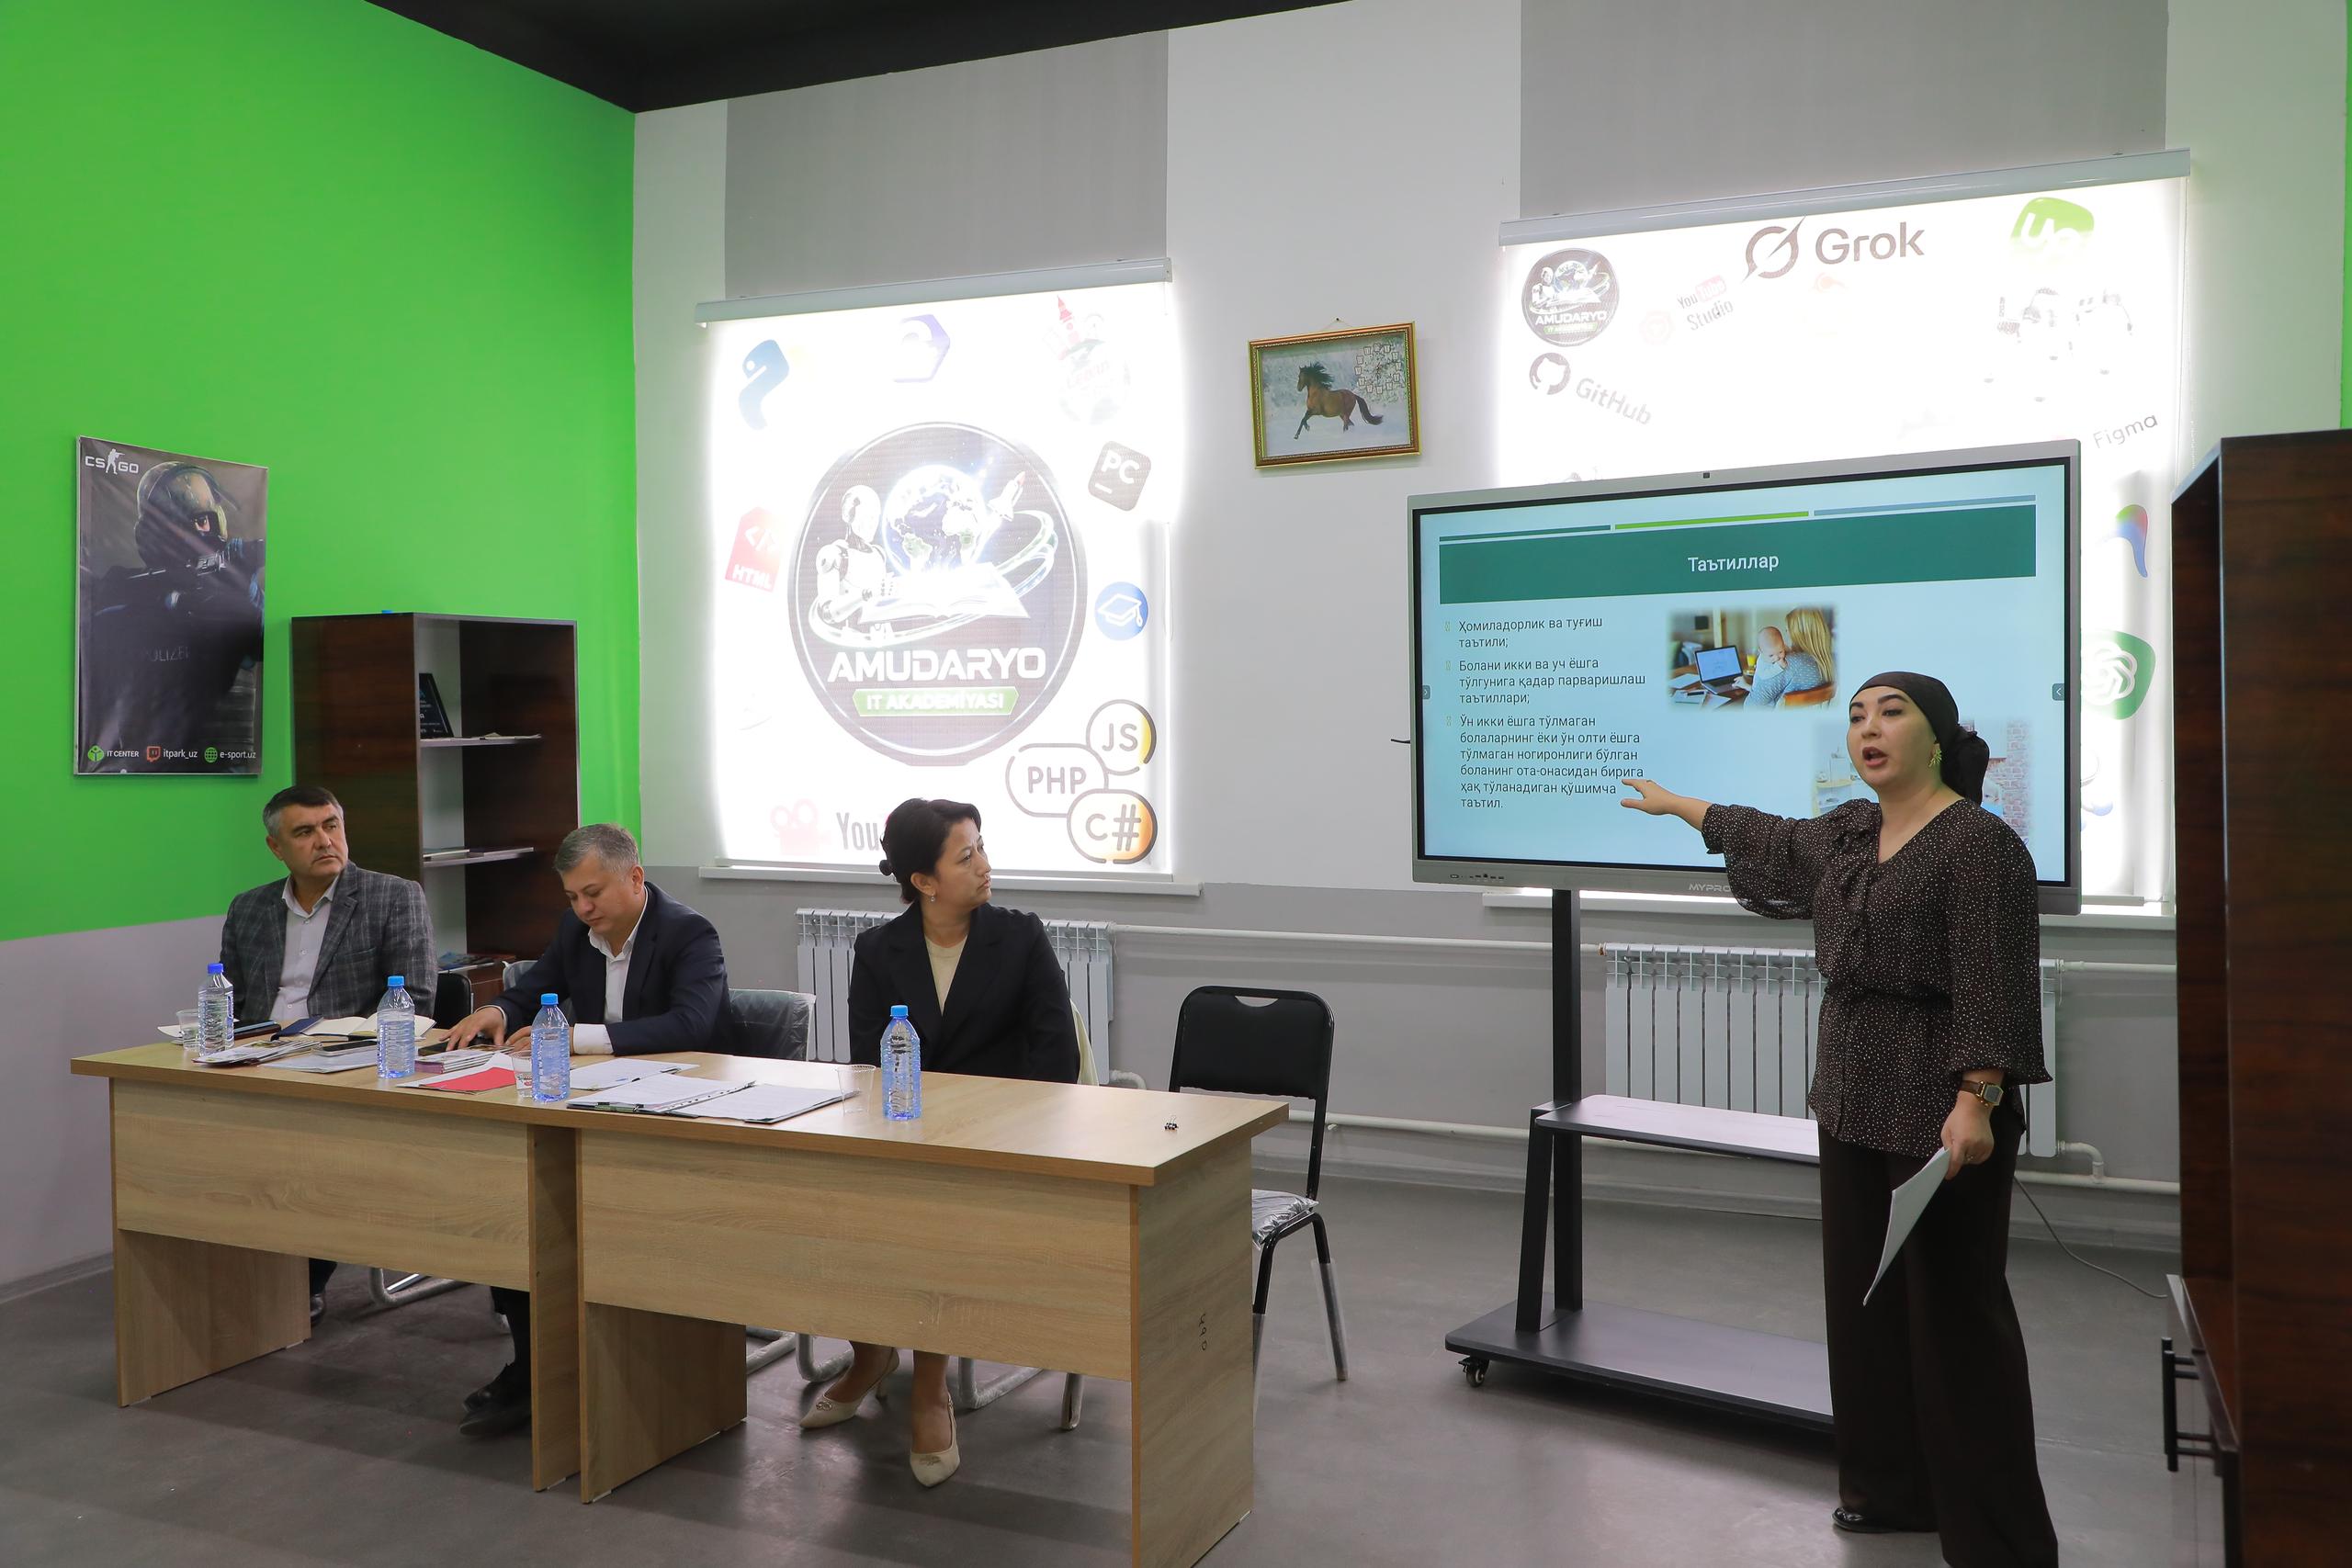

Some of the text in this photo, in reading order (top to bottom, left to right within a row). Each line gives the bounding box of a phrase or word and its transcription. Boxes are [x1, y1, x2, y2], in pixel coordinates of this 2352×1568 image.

[1815, 221, 1926, 265] Grok
[1534, 310, 1607, 325] AMUDARYO
[1686, 299, 1734, 331] Studio
[1575, 377, 1654, 425] GitHub
[2092, 414, 2159, 449] Figma
[1101, 449, 1140, 485] PC
[1688, 555, 1780, 572] Таътиллар
[732, 564, 771, 589] HTML
[1459, 616, 1603, 634] Ҳомиладорлик ва туғиш
[1459, 637, 1509, 649] таътили;
[826, 647, 1047, 683] AMUDARYO
[1459, 658, 1599, 672] Болани икки ва уч ёшга
[1459, 673, 1645, 691] тўлгунига қадар парваришлаш
[866, 694, 883, 710] IT
[1459, 692, 1530, 705] таътиллари;
[1459, 714, 1596, 729] Ўн икки ёшга тўлмаган
[1102, 722, 1138, 752] JS
[1460, 731, 1640, 746] болаларнинг ёки ўн олти ёшга
[163, 749, 198, 760] itpark_uz
[220, 750, 256, 761] e-sport.uz
[1460, 748, 1638, 762] тўлмаган ногиронлиги бўлган
[1027, 765, 1087, 795] PHP
[1460, 764, 1644, 780] боланинг ота-онасидан бирига
[1460, 782, 1616, 795] ҳақ тўланадиган қўшимча
[1461, 798, 1503, 808] таътил.
[1085, 804, 1142, 852] C#
